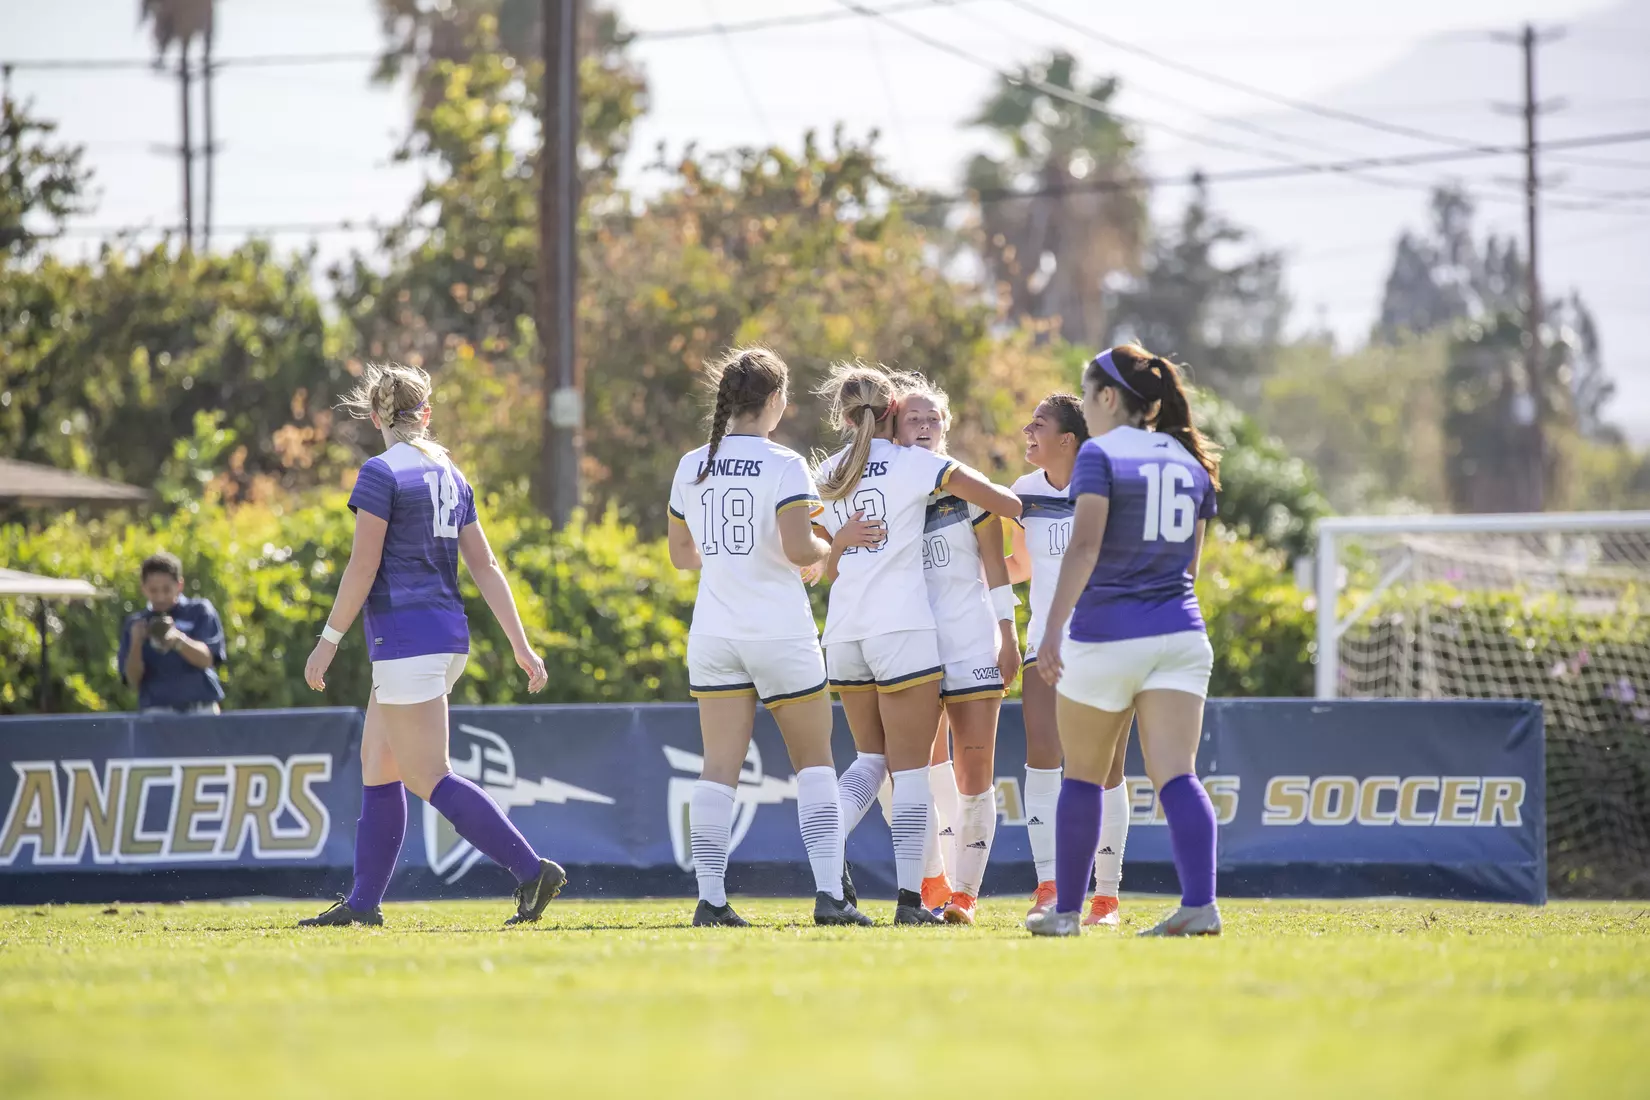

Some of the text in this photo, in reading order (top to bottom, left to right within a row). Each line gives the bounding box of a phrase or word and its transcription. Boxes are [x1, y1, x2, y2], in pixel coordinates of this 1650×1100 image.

[696, 458, 763, 477] LANCERS
[423, 470, 459, 539] 18
[701, 487, 754, 555] 18
[833, 488, 889, 555] 13
[1138, 462, 1195, 543] 16
[1048, 522, 1070, 556] 11
[972, 666, 1000, 680] WAC
[1261, 775, 1526, 827] SOCCER
